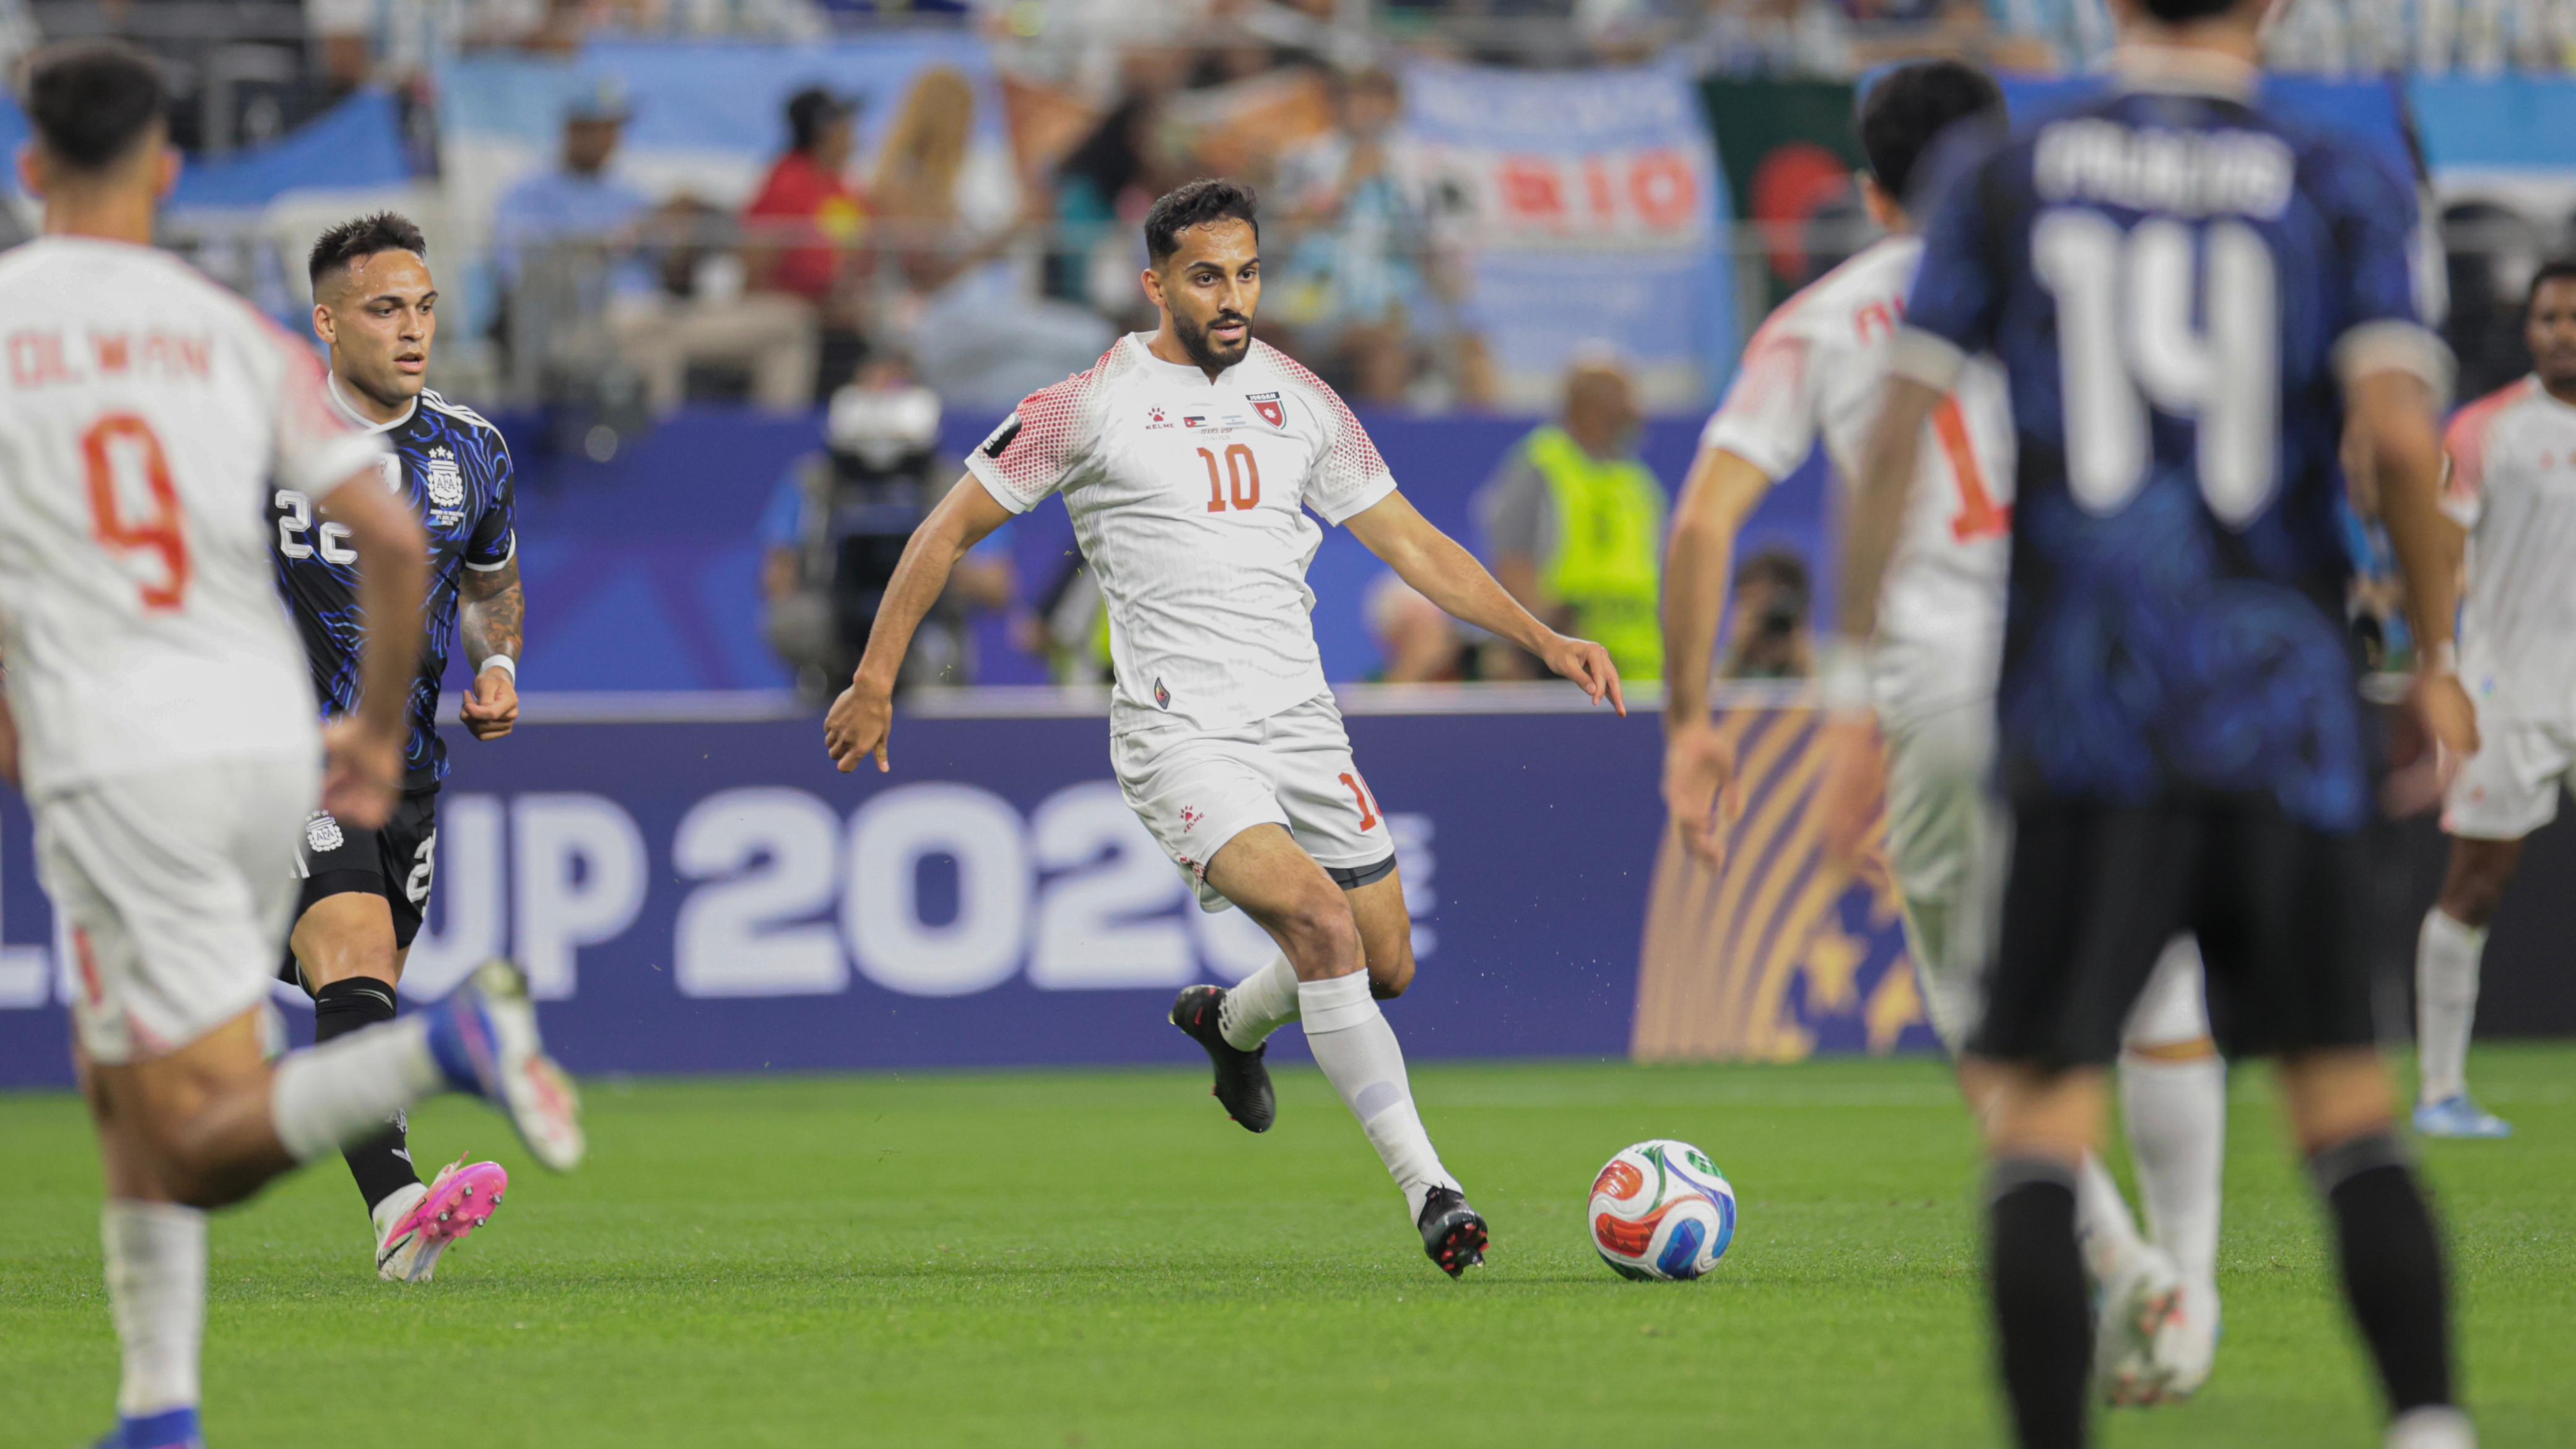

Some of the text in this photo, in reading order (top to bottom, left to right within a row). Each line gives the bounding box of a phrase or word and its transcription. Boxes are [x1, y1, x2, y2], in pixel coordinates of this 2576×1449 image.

[9, 330, 213, 386] OLWAN
[2032, 209, 2278, 528] 14
[1250, 393, 1276, 401] JORDAN
[437, 472, 455, 492] AFA
[1196, 443, 1260, 512] 10
[82, 410, 191, 613] 9
[1183, 812, 1204, 833] KELME
[1338, 772, 1383, 833] 1
[316, 826, 334, 840] AFA
[272, 793, 649, 1006] UP
